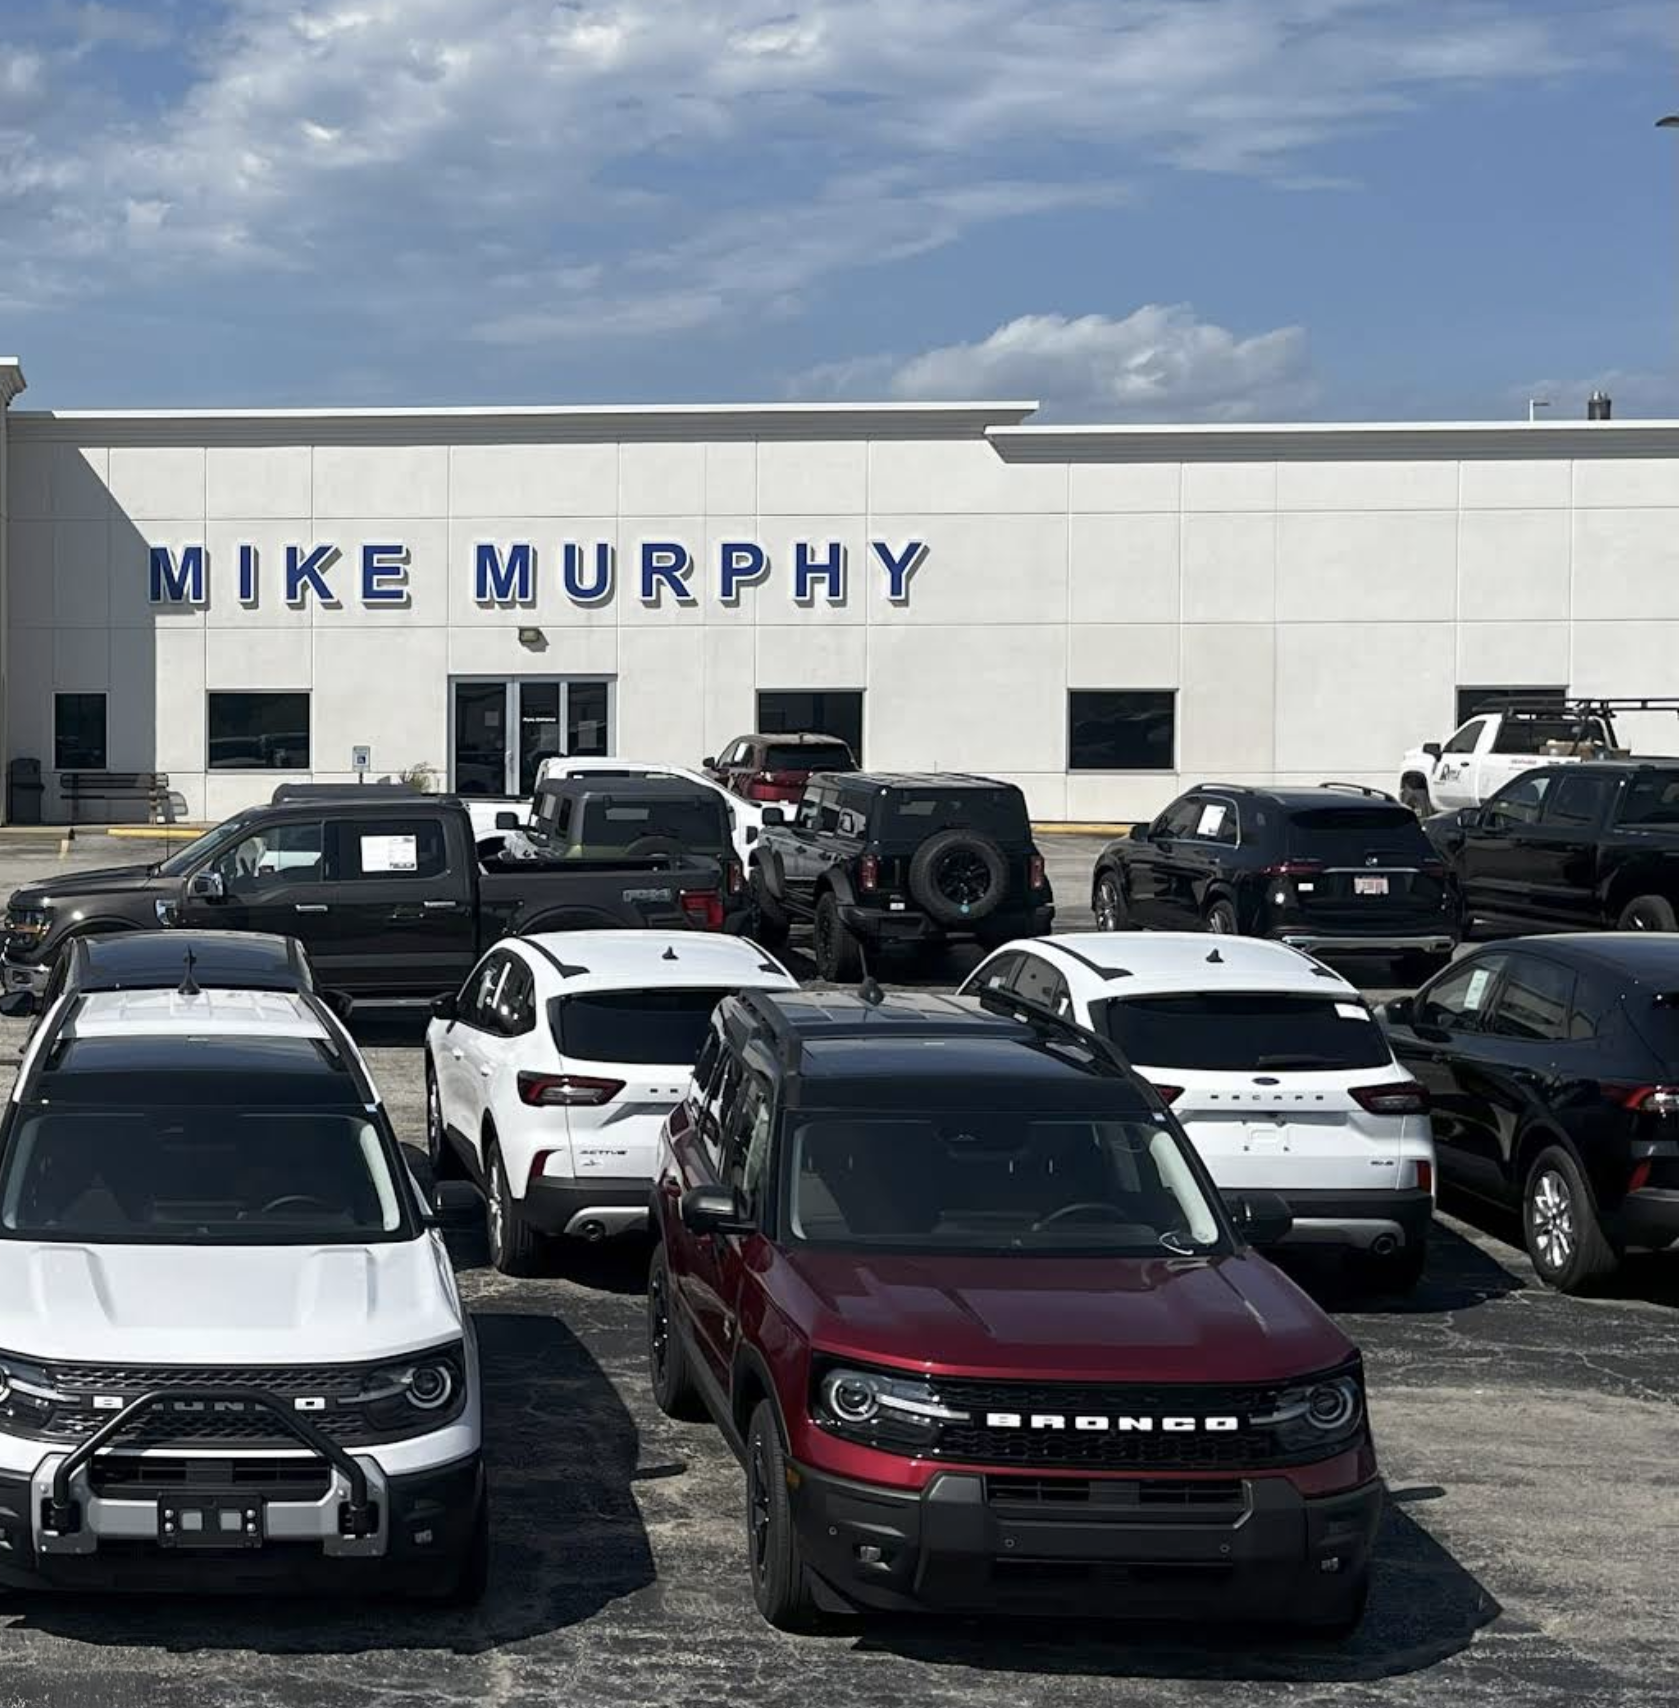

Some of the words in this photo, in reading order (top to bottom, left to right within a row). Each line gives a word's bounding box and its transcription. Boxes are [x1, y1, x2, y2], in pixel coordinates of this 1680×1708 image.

[149, 543, 404, 602] MIKE
[475, 541, 923, 600] MURPHY
[987, 1413, 1238, 1431] BRONCO
